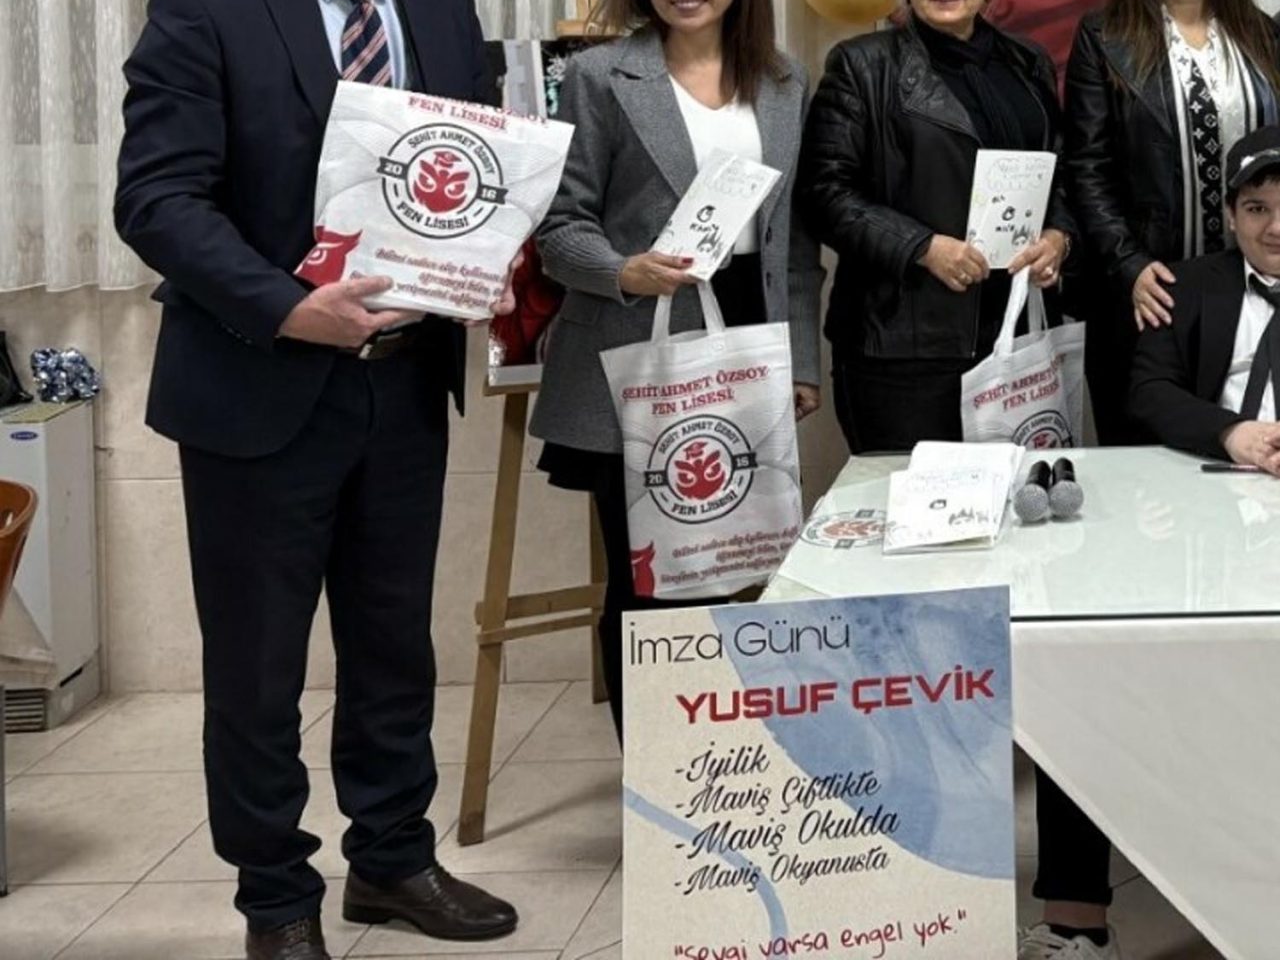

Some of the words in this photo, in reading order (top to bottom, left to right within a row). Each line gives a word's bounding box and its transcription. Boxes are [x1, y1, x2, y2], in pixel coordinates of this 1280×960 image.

[408, 96, 445, 115] FEN
[716, 366, 768, 384] ÖZSOY
[652, 402, 676, 415] FEN
[630, 622, 724, 666] İmza
[734, 615, 851, 657] Günü
[676, 681, 838, 725] YUSUF
[852, 665, 995, 714] ÇEVİK
[780, 770, 882, 815] Çiftlikte
[798, 805, 901, 846] Okulda
[770, 846, 891, 889] Okyanusta
[759, 932, 830, 958] varsa
[841, 921, 904, 959] engel
